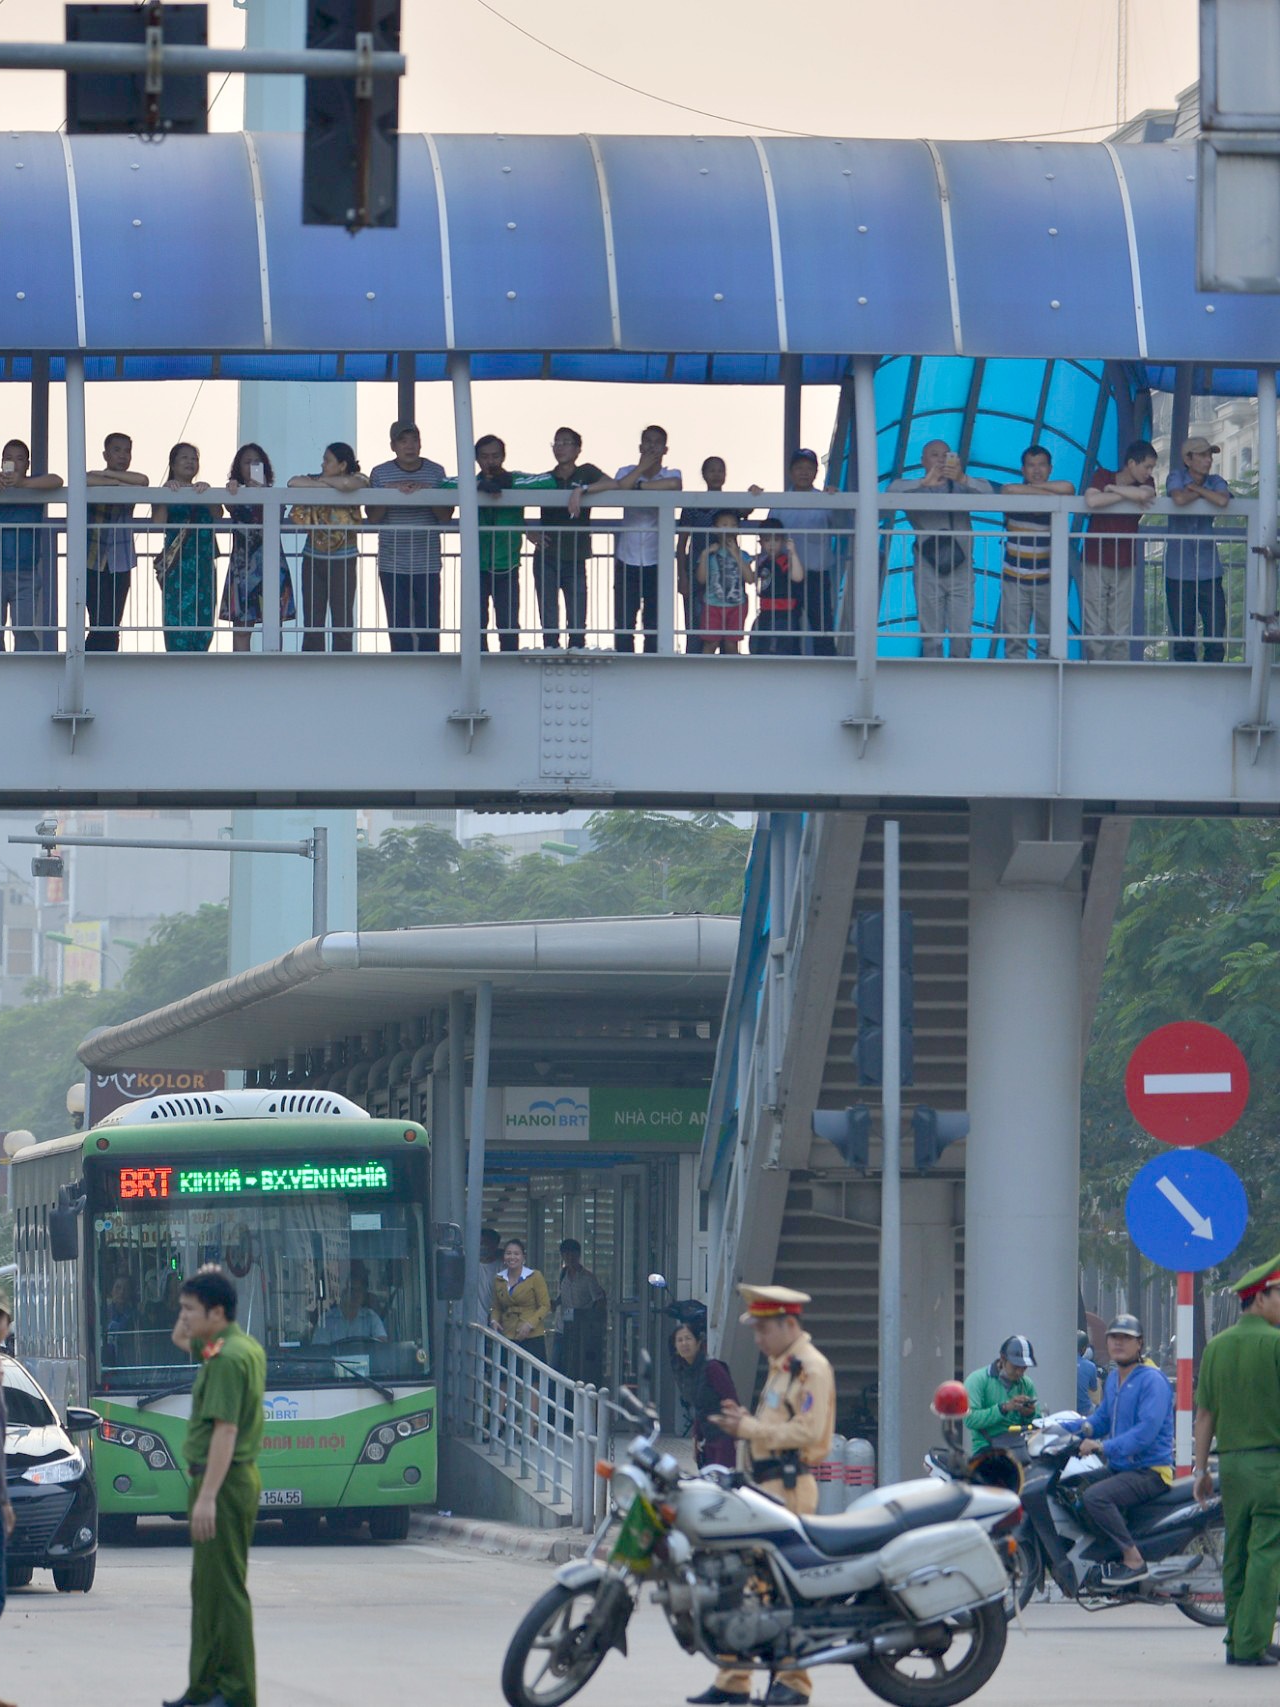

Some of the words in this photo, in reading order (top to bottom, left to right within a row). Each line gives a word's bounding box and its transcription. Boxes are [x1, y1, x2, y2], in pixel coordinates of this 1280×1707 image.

[506, 1114, 556, 1127] HANOI
[558, 1114, 588, 1127] BRT
[614, 1107, 647, 1126] NHÀ
[649, 1107, 684, 1126] CHỜ
[120, 1167, 172, 1198] BRT
[179, 1171, 212, 1193] KIM
[275, 1409, 299, 1420] BRT
